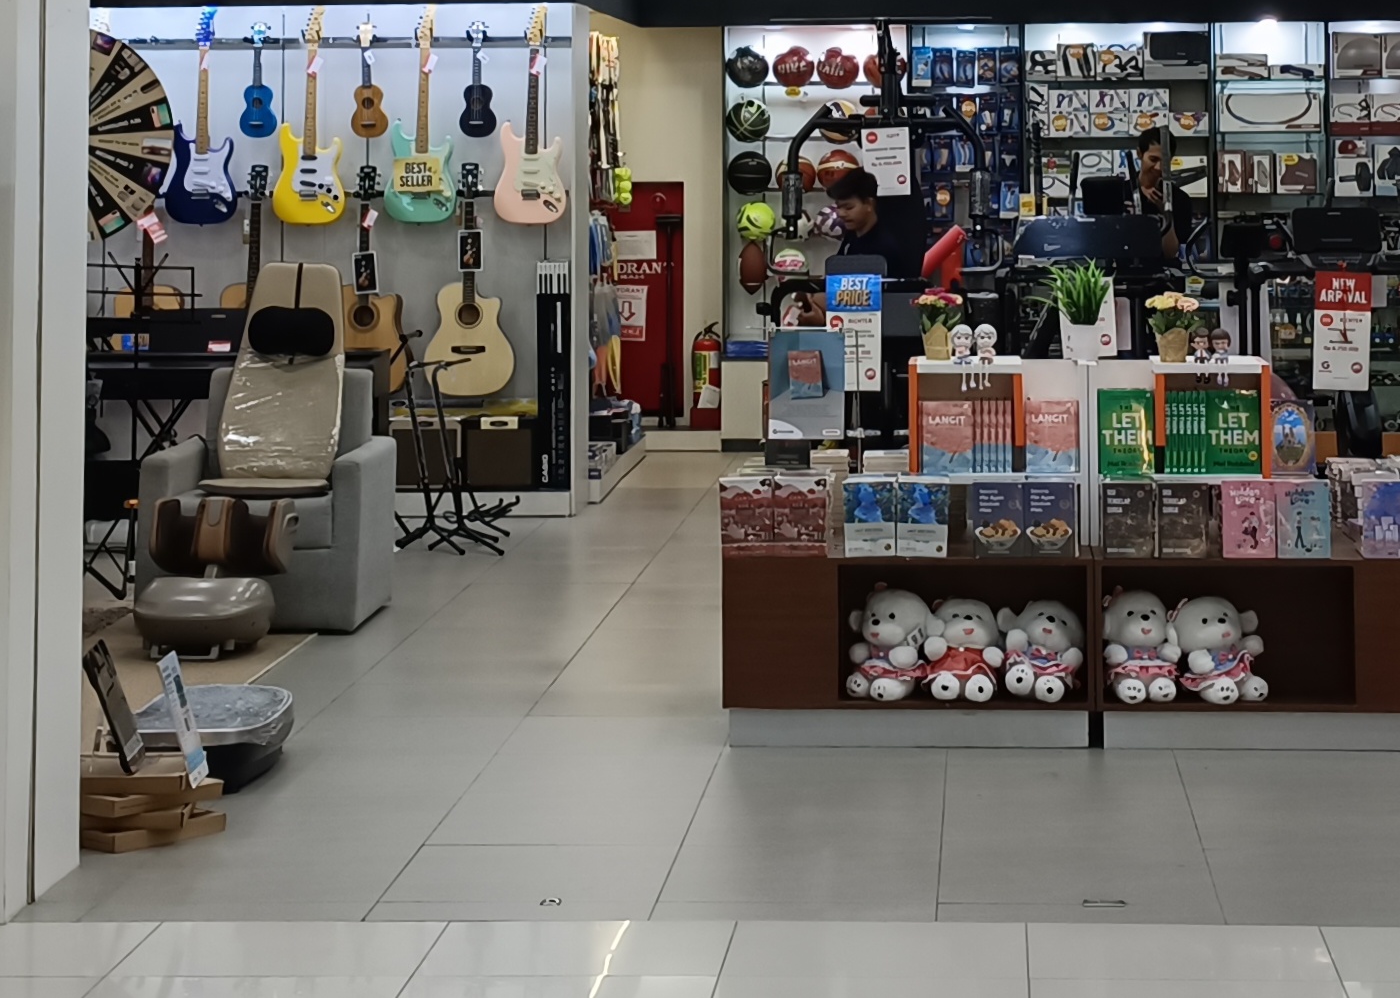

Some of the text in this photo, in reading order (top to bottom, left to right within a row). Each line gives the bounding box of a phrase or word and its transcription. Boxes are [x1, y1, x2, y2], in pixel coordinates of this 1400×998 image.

[404, 162, 428, 174] BEST
[399, 175, 432, 188] SELLER
[841, 277, 869, 290] BEST
[1332, 277, 1356, 290] NEW
[836, 290, 871, 306] PRICE
[1112, 412, 1142, 428] LET
[1218, 412, 1250, 428] LET
[1101, 429, 1153, 445] THEM
[1208, 429, 1259, 445] THEM
